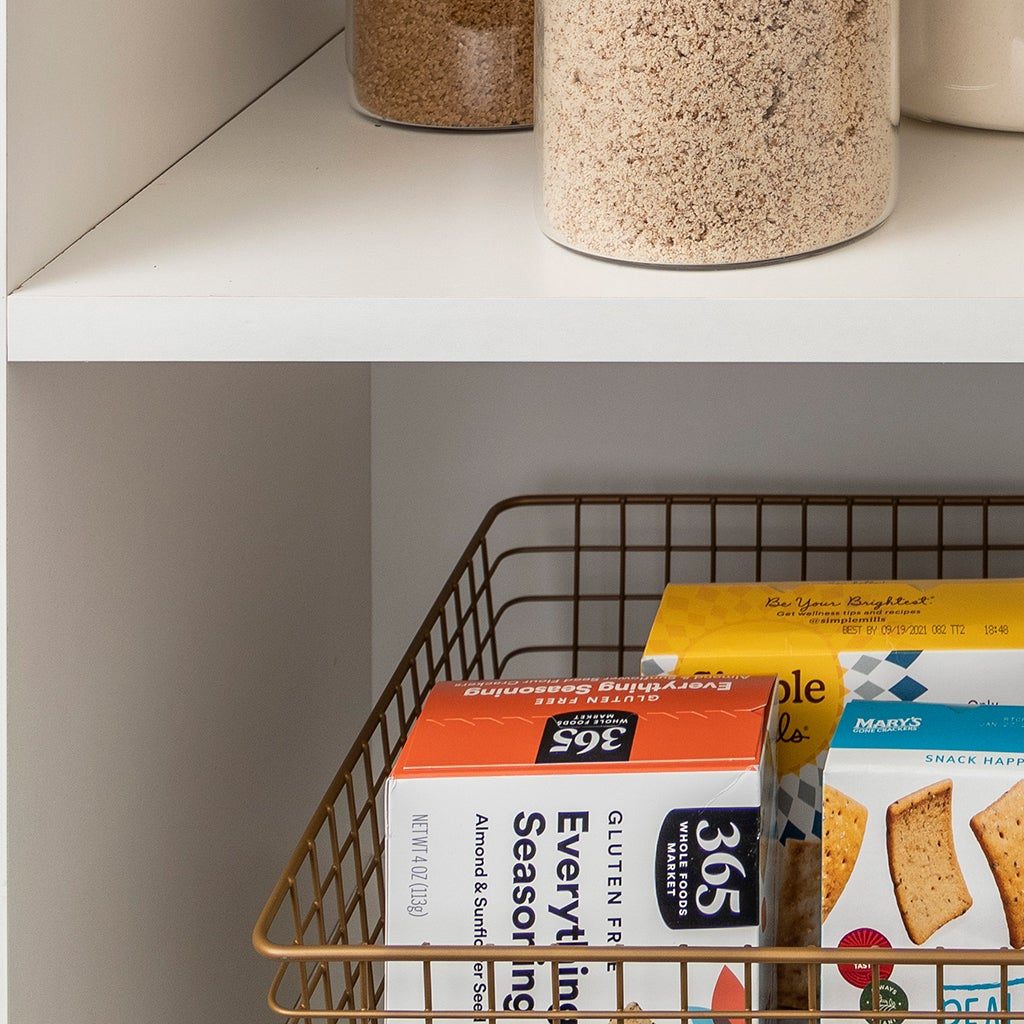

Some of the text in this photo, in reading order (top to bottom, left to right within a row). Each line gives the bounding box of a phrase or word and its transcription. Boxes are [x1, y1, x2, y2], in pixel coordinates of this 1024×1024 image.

[765, 597, 791, 608] Be
[795, 596, 841, 612] Your
[843, 609, 862, 617] tips
[808, 617, 887, 625] @simplemills
[842, 625, 863, 635] BEST
[866, 625, 878, 635] BY
[880, 625, 928, 635] 09/19/2021
[930, 625, 947, 635] 082
[983, 625, 1010, 636] 18:48
[463, 680, 733, 698] Everything Seasoning
[534, 694, 660, 706] GLUTEN FREE
[854, 716, 923, 728] MARY'S
[549, 726, 628, 755] 365
[925, 754, 977, 765] SNACK
[474, 813, 489, 877] Almond
[407, 814, 429, 918] NET WT 4 OZ (113g)
[666, 842, 677, 897] MARKET
[678, 820, 689, 917] WHOLE FOODS
[695, 819, 747, 916] 365
[474, 881, 488, 894] &
[607, 810, 623, 972] GLUTEN FRE
[474, 897, 488, 979] Sunfloer
